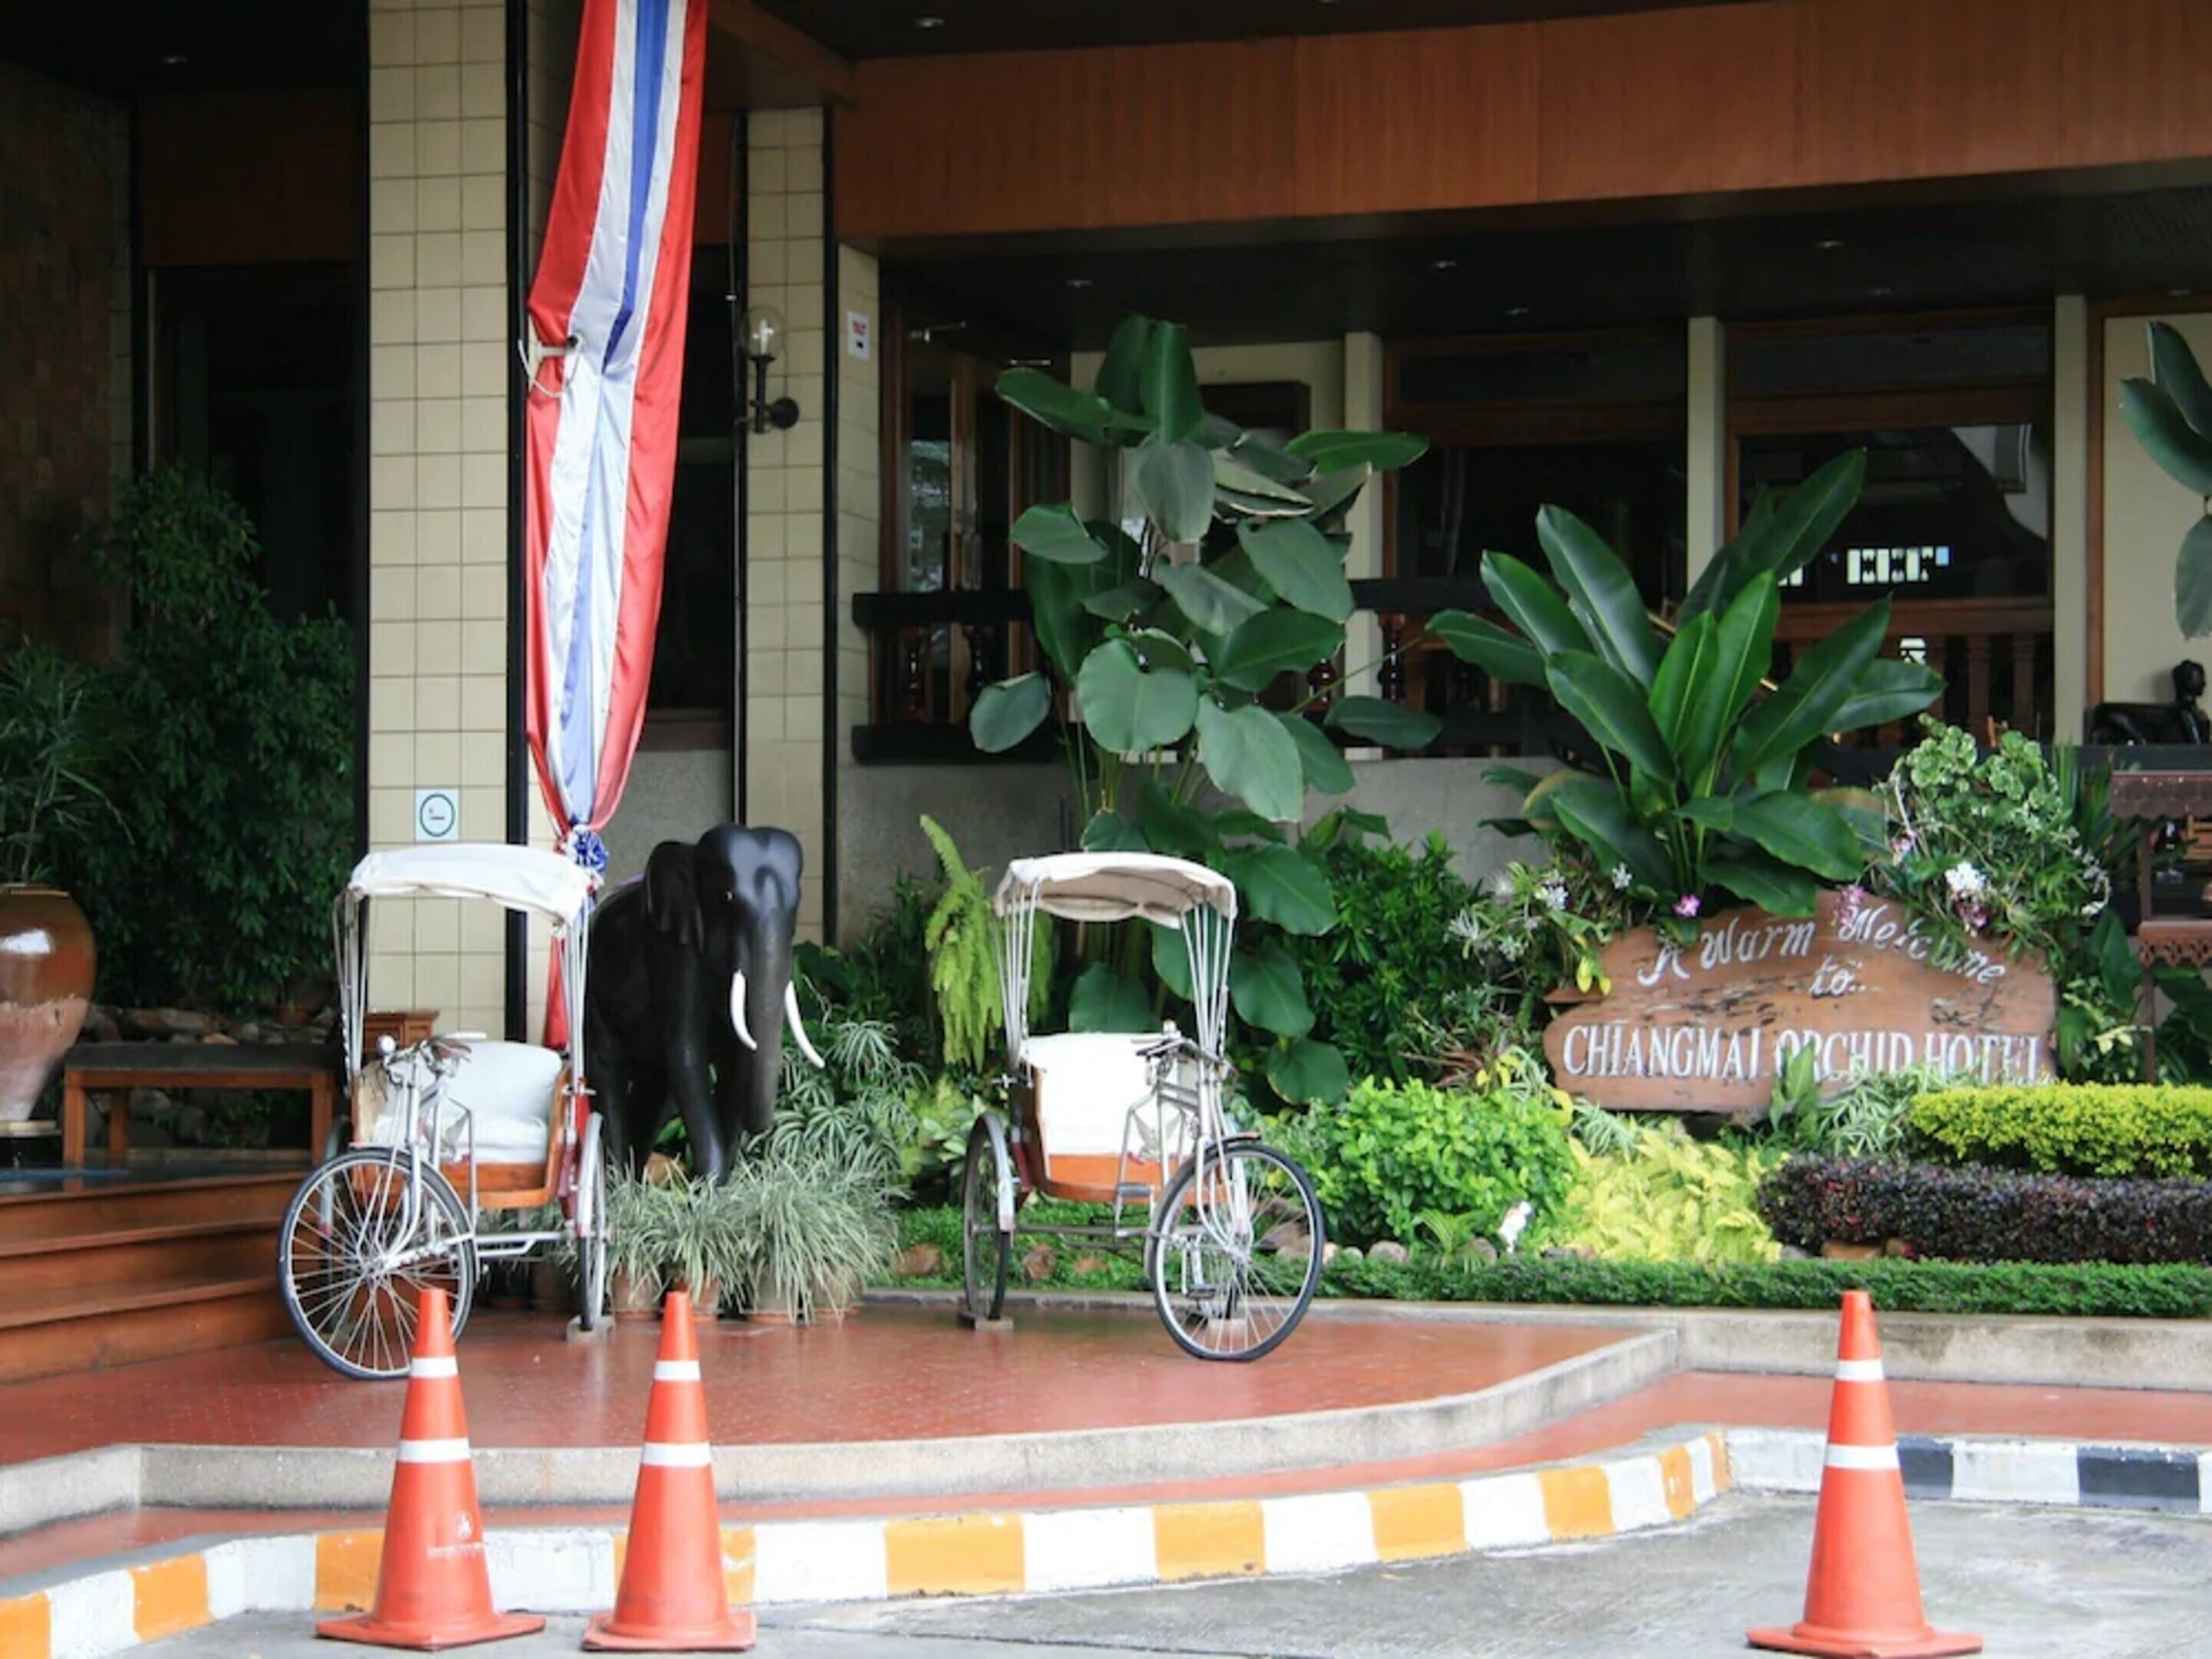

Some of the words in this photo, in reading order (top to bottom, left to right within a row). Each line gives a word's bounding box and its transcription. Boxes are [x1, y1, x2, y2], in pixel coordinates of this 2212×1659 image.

[1637, 941, 1690, 986] A
[1700, 916, 1815, 970] Warm
[1563, 1024, 1763, 1080] CHIANGMAI
[1775, 1029, 1914, 1083] ORCHID
[1924, 1032, 2043, 1085] HOTEL
